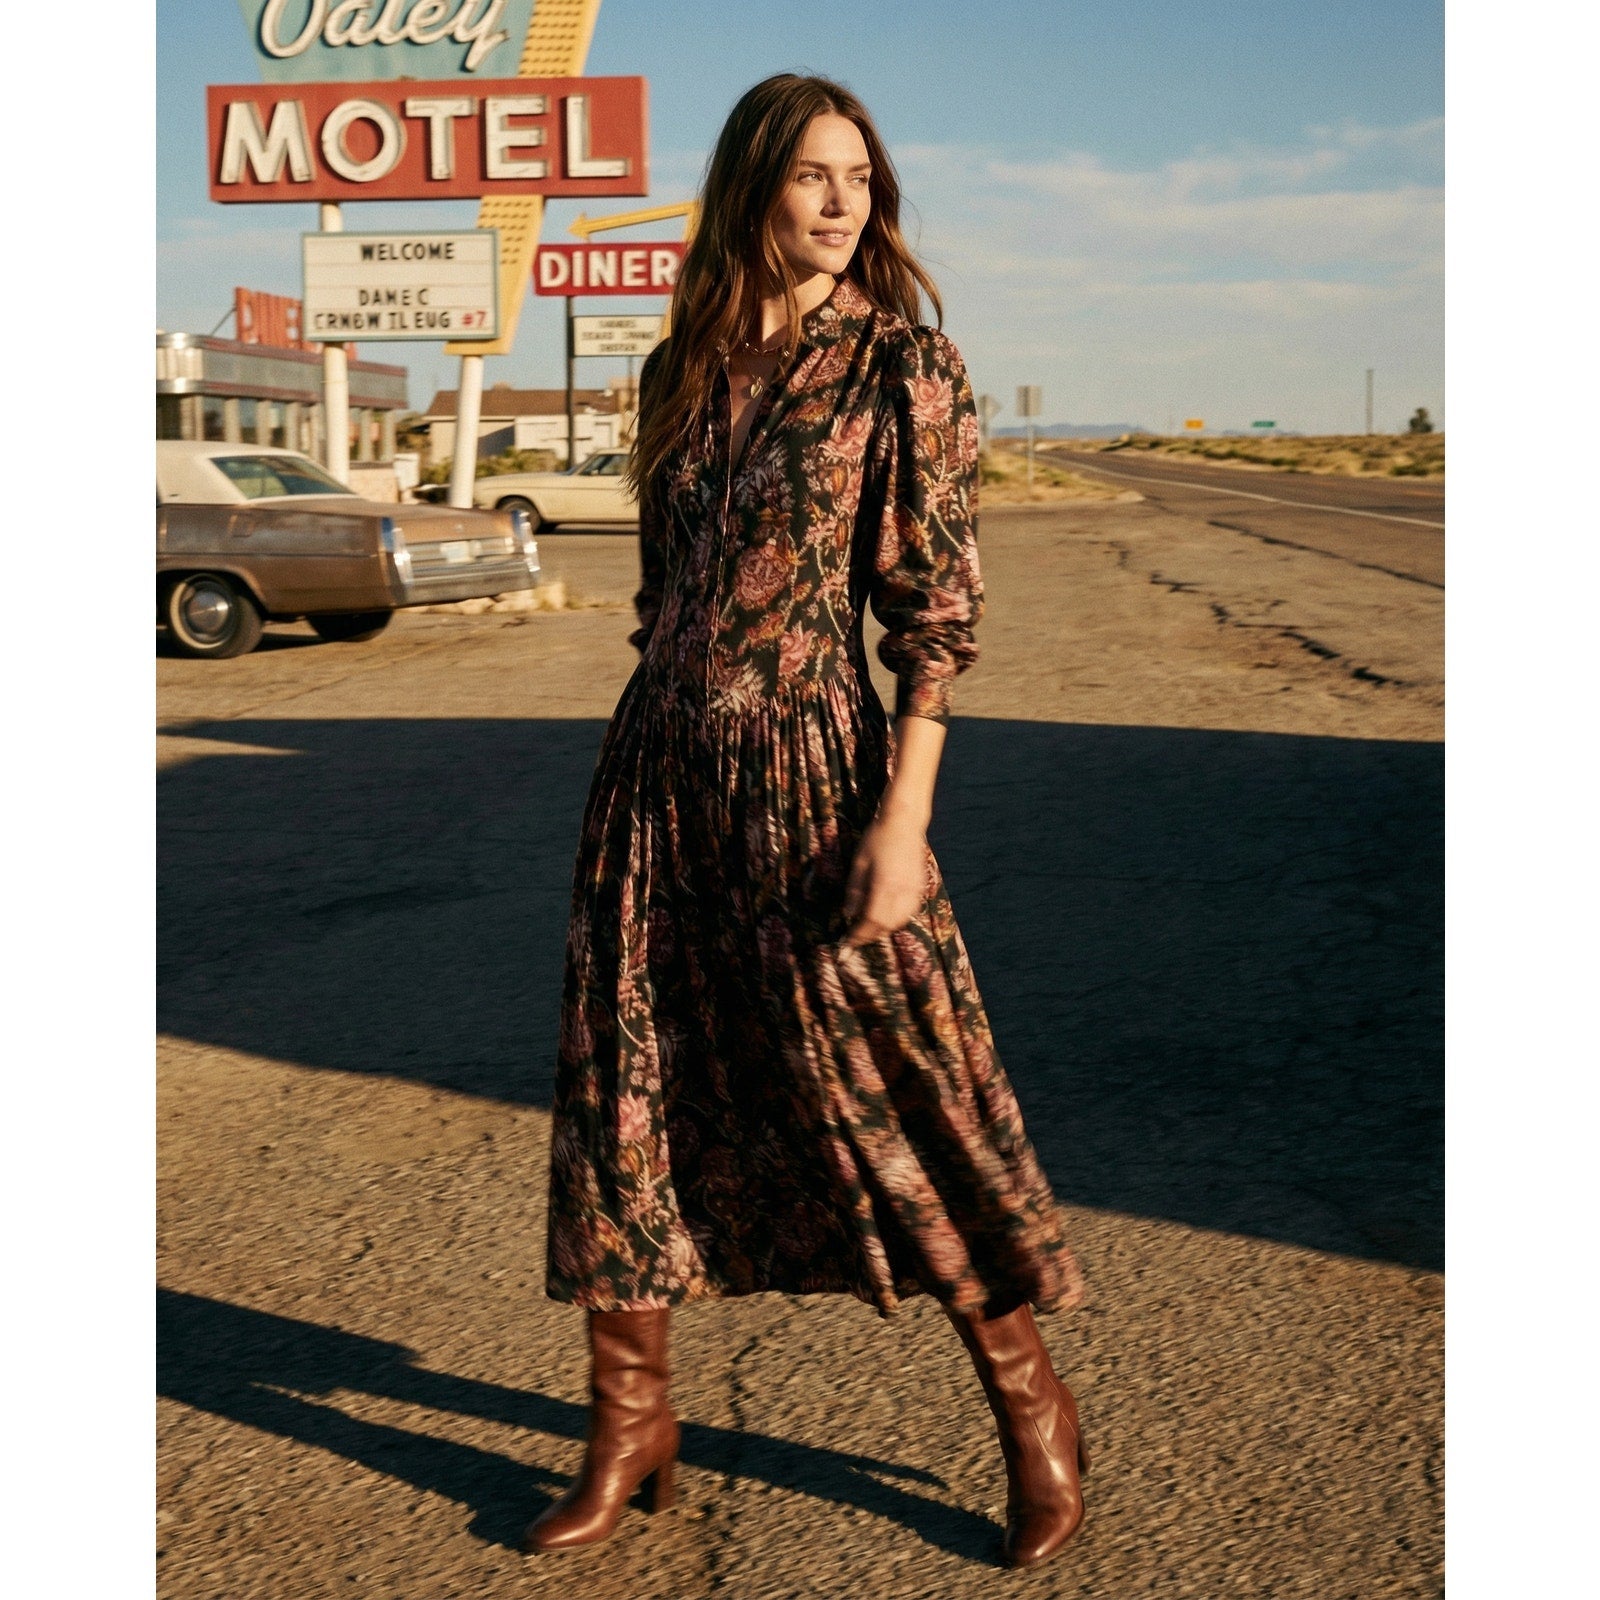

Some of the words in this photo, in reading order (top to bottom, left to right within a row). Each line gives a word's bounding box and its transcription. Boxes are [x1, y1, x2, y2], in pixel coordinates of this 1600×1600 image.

[219, 94, 630, 184] MOTEL
[360, 241, 456, 262] WELCOME
[539, 250, 679, 288] DINER
[461, 311, 488, 328] #7
